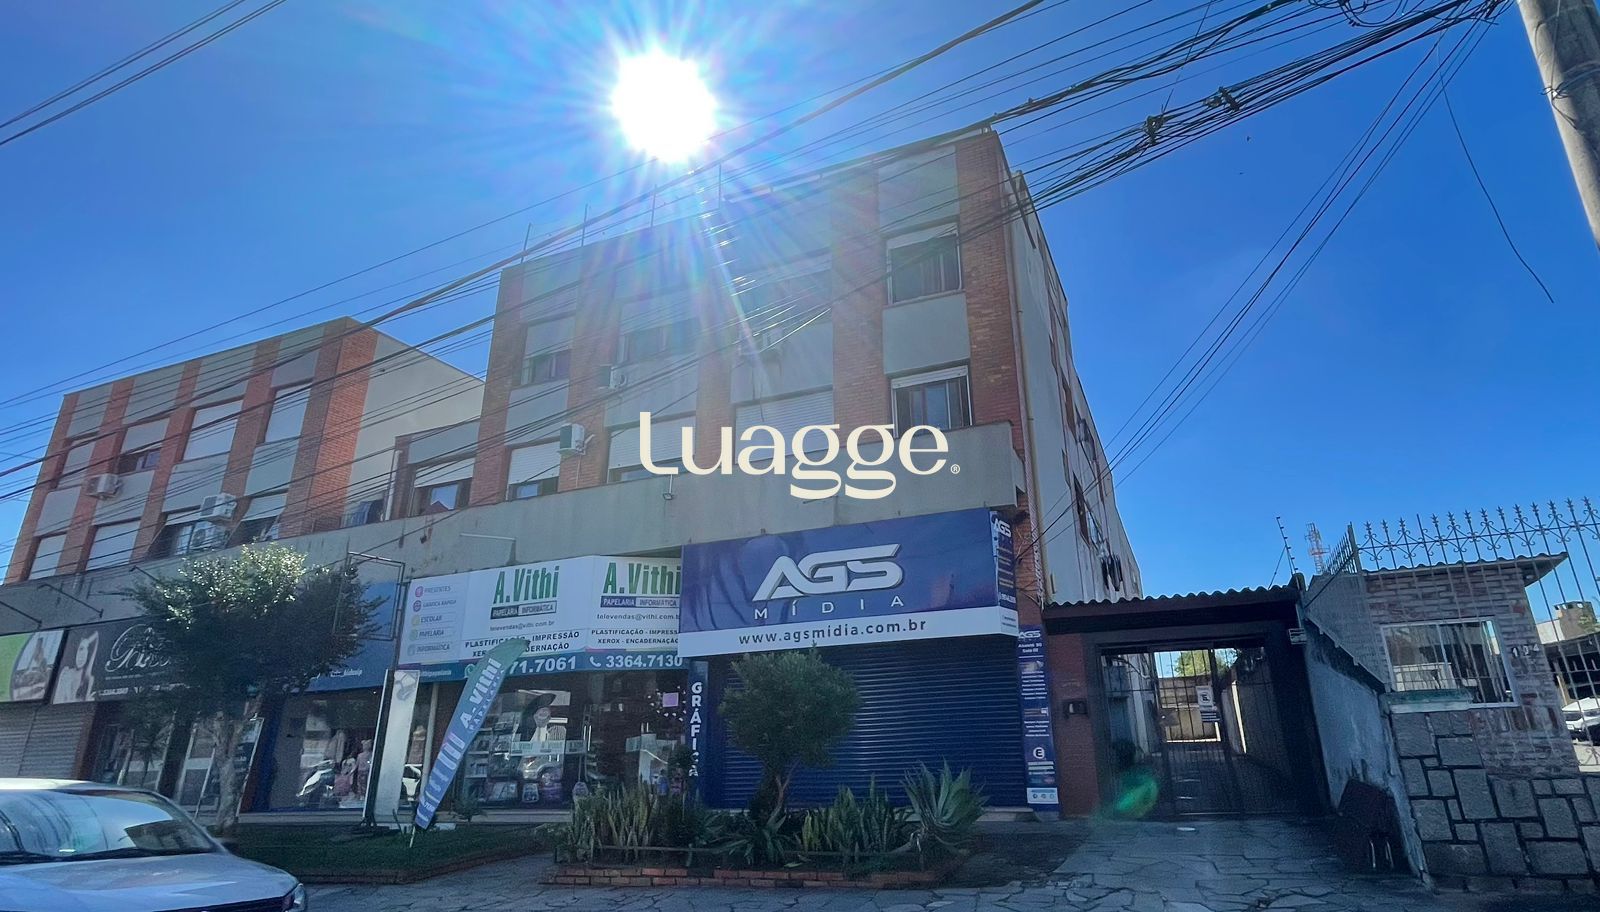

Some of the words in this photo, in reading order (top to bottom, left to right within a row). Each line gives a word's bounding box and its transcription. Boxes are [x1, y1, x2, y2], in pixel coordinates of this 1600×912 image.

[493, 565, 560, 604] A.Vithi
[602, 562, 681, 594] A.Vithi
[752, 543, 903, 602] AGS
[597, 613, 680, 621] televendas@vithi.com.b
[754, 596, 904, 620] MÍDIA
[532, 631, 580, 642] IMPRESSÃO
[738, 619, 927, 645] www.agsmidia.com.br
[526, 642, 570, 653] DERNAÇÃO
[605, 654, 683, 668] 3364.7130
